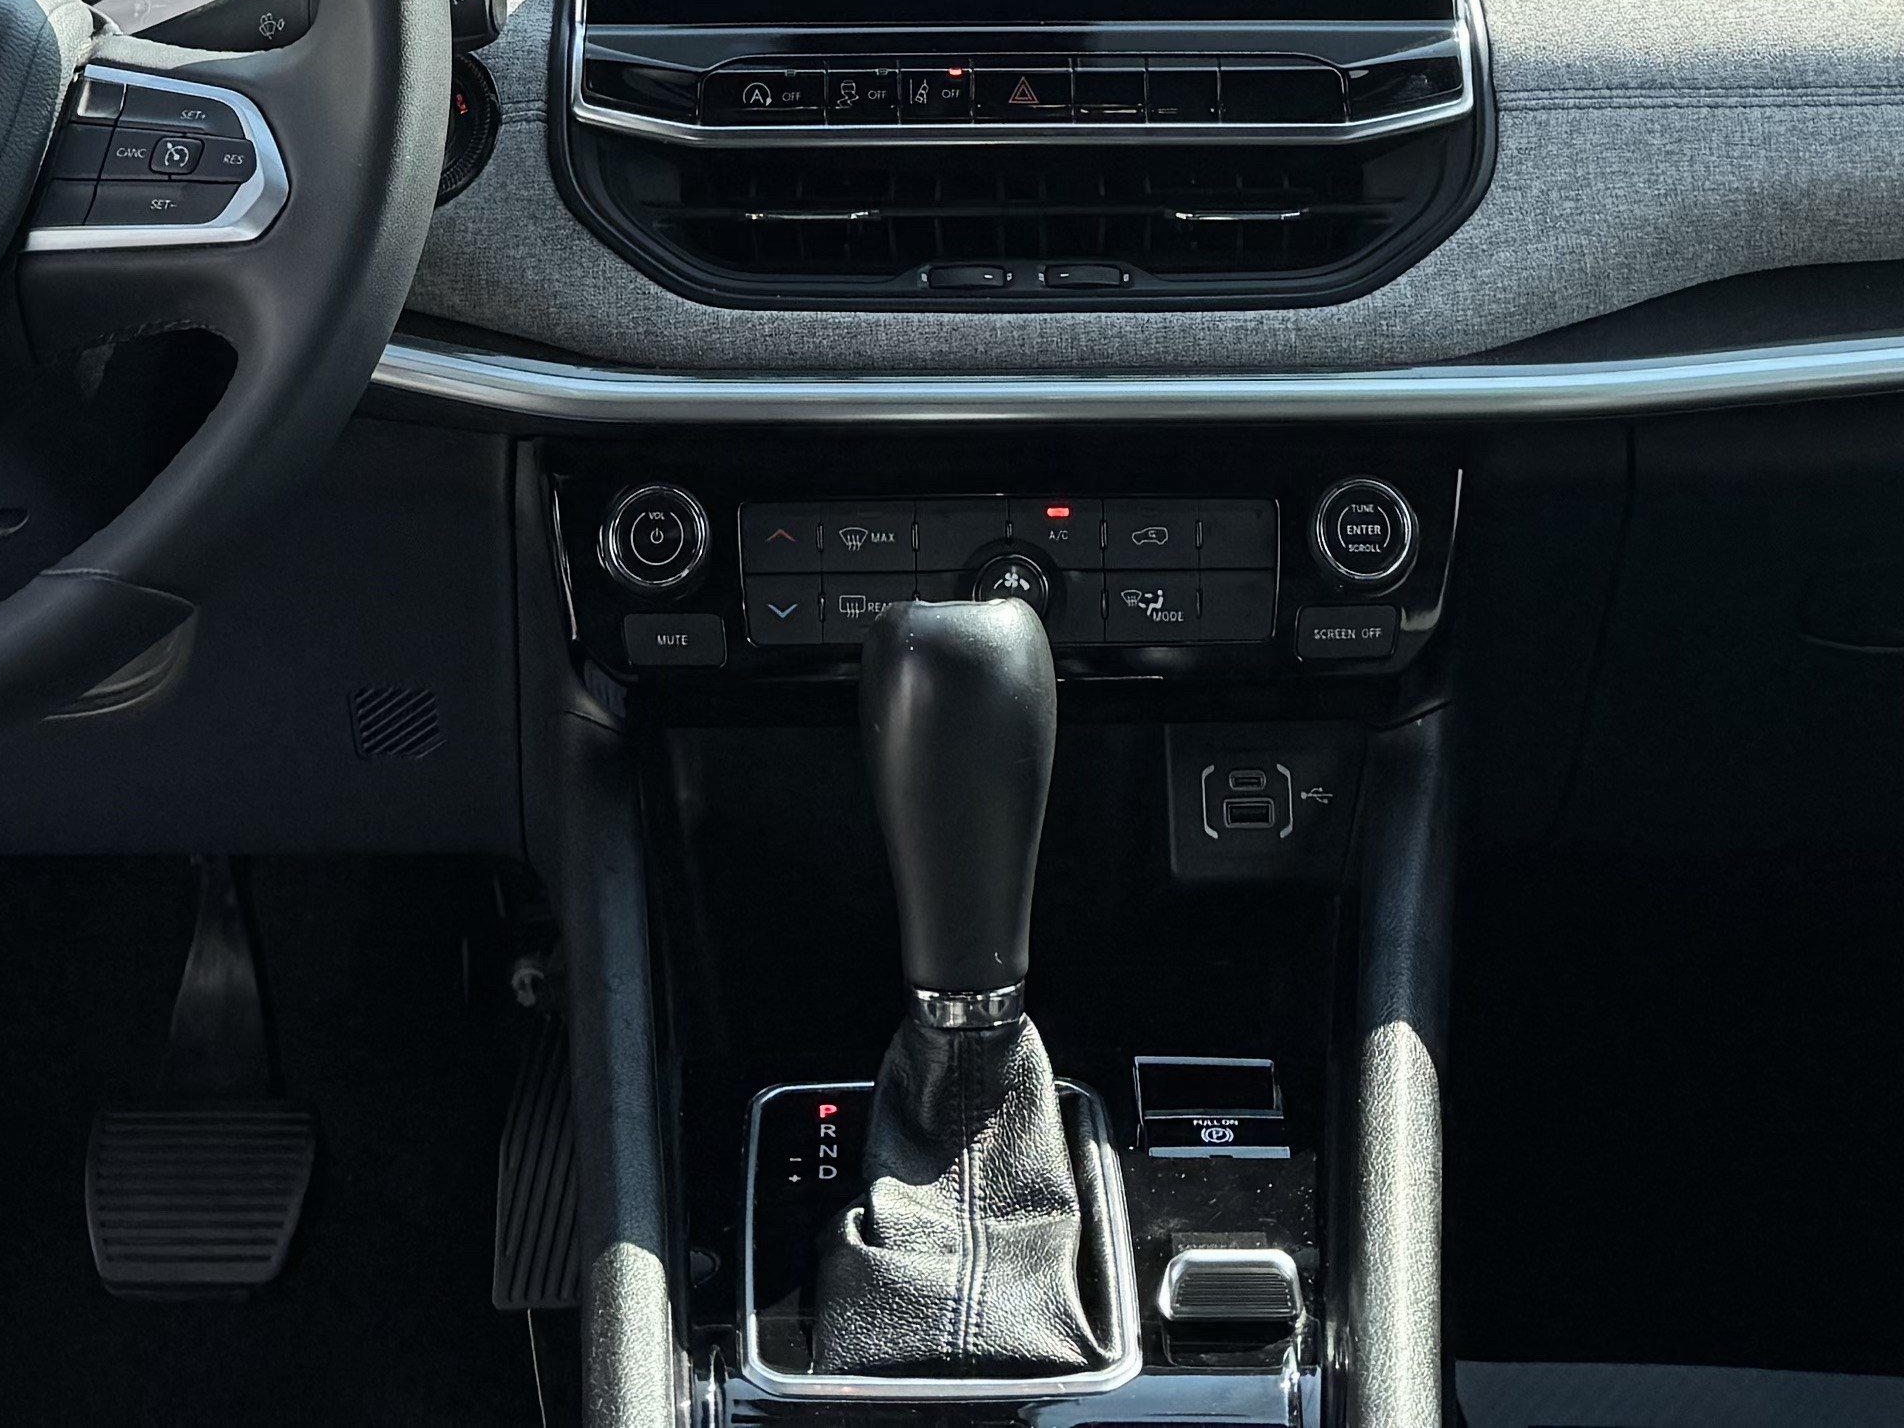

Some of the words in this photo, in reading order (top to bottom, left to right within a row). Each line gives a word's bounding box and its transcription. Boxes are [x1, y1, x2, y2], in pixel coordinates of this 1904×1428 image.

[782, 91, 802, 101] OFF
[867, 90, 888, 100] OFF
[941, 89, 961, 99] OFF
[222, 153, 245, 165] RES
[1351, 504, 1375, 514] TUNE
[648, 511, 666, 520] VOL
[1048, 530, 1069, 541] A/C
[1346, 524, 1382, 536] ENTER
[870, 532, 896, 544] MAX
[1153, 611, 1185, 622] MODE
[657, 634, 689, 647] MUTE
[1313, 628, 1356, 641] SCREEN
[1360, 628, 1383, 640] OFF
[819, 1104, 838, 1118] P
[820, 1124, 837, 1137] R
[819, 1144, 838, 1158] N
[818, 1165, 838, 1179] D
